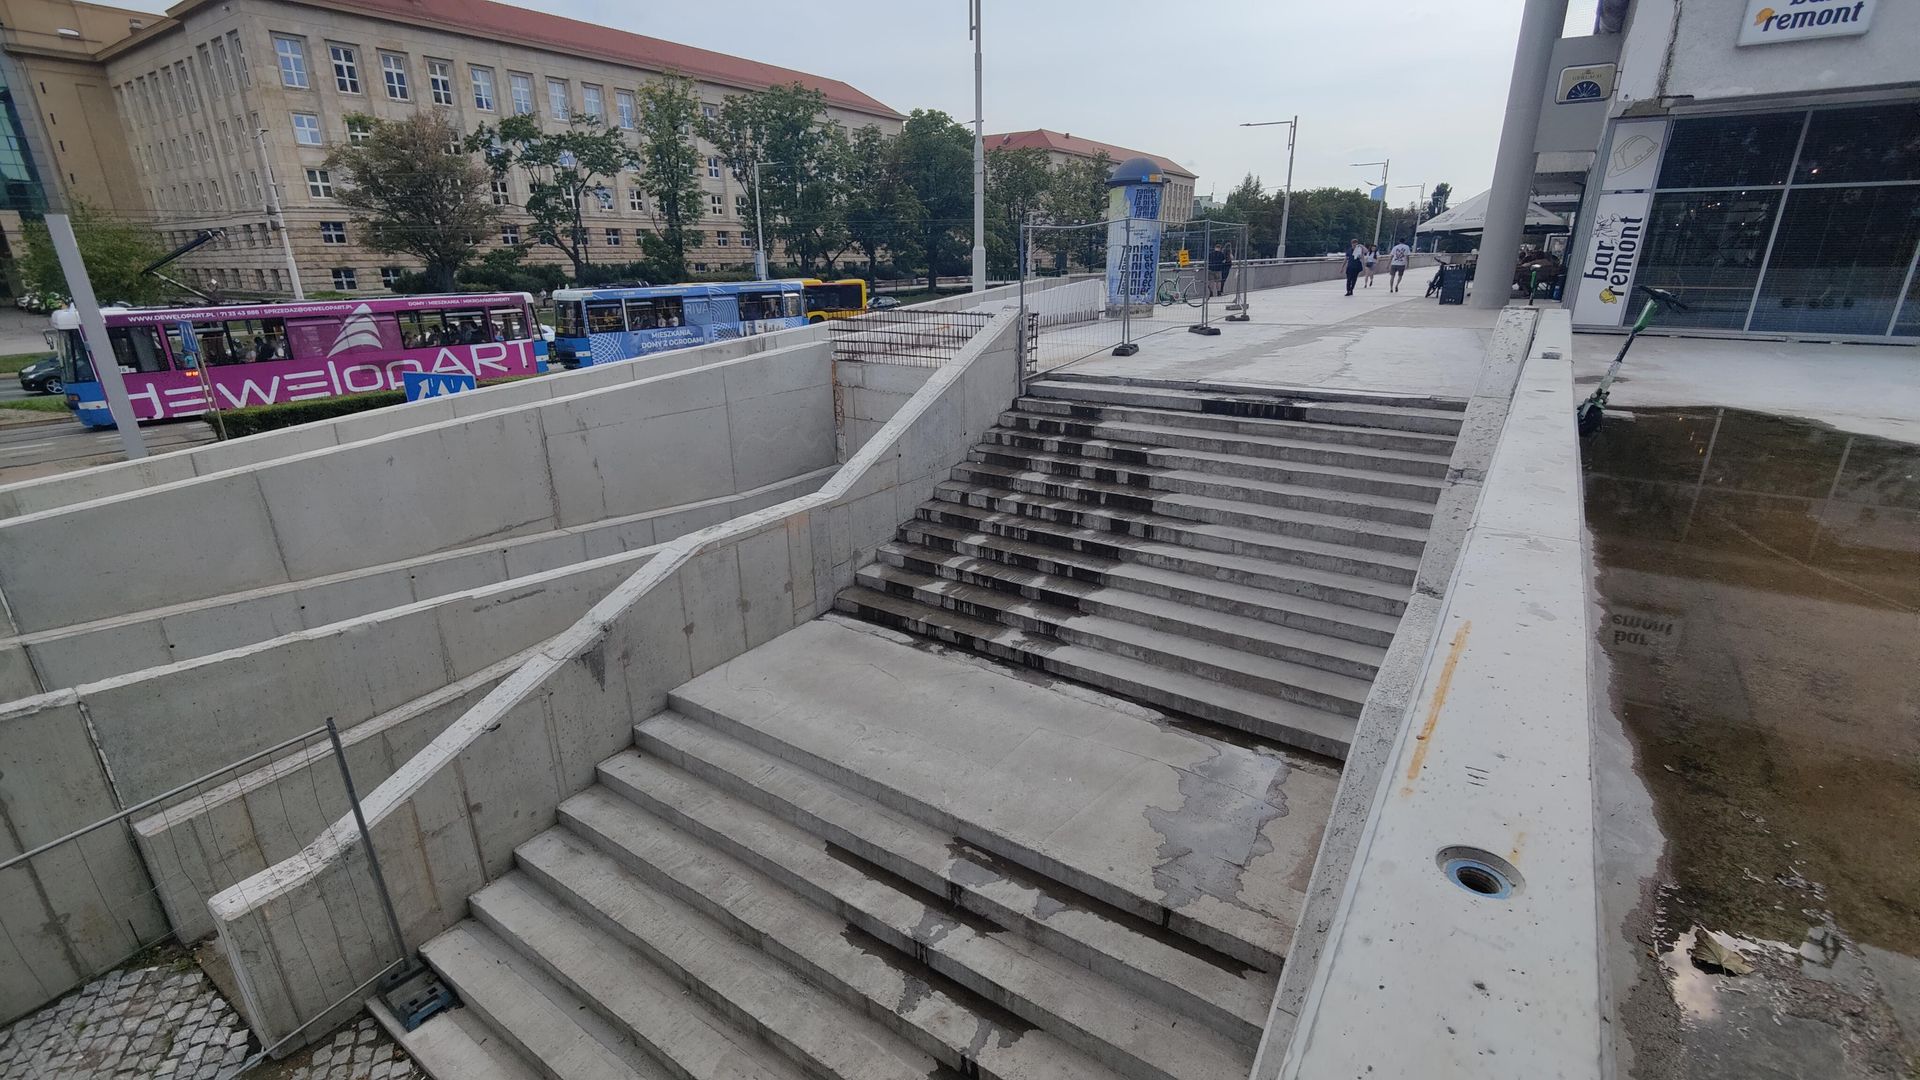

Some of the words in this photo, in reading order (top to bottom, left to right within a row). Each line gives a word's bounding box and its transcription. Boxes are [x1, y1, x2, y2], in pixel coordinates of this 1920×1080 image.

[1762, 1, 1864, 32] remont
[1583, 240, 1615, 281] bar
[1608, 216, 1643, 296] remont
[685, 302, 709, 314] RIVA
[641, 341, 662, 349] DOMY
[669, 336, 704, 346] OGRODAMI
[651, 329, 693, 339] MIESZKANIA,
